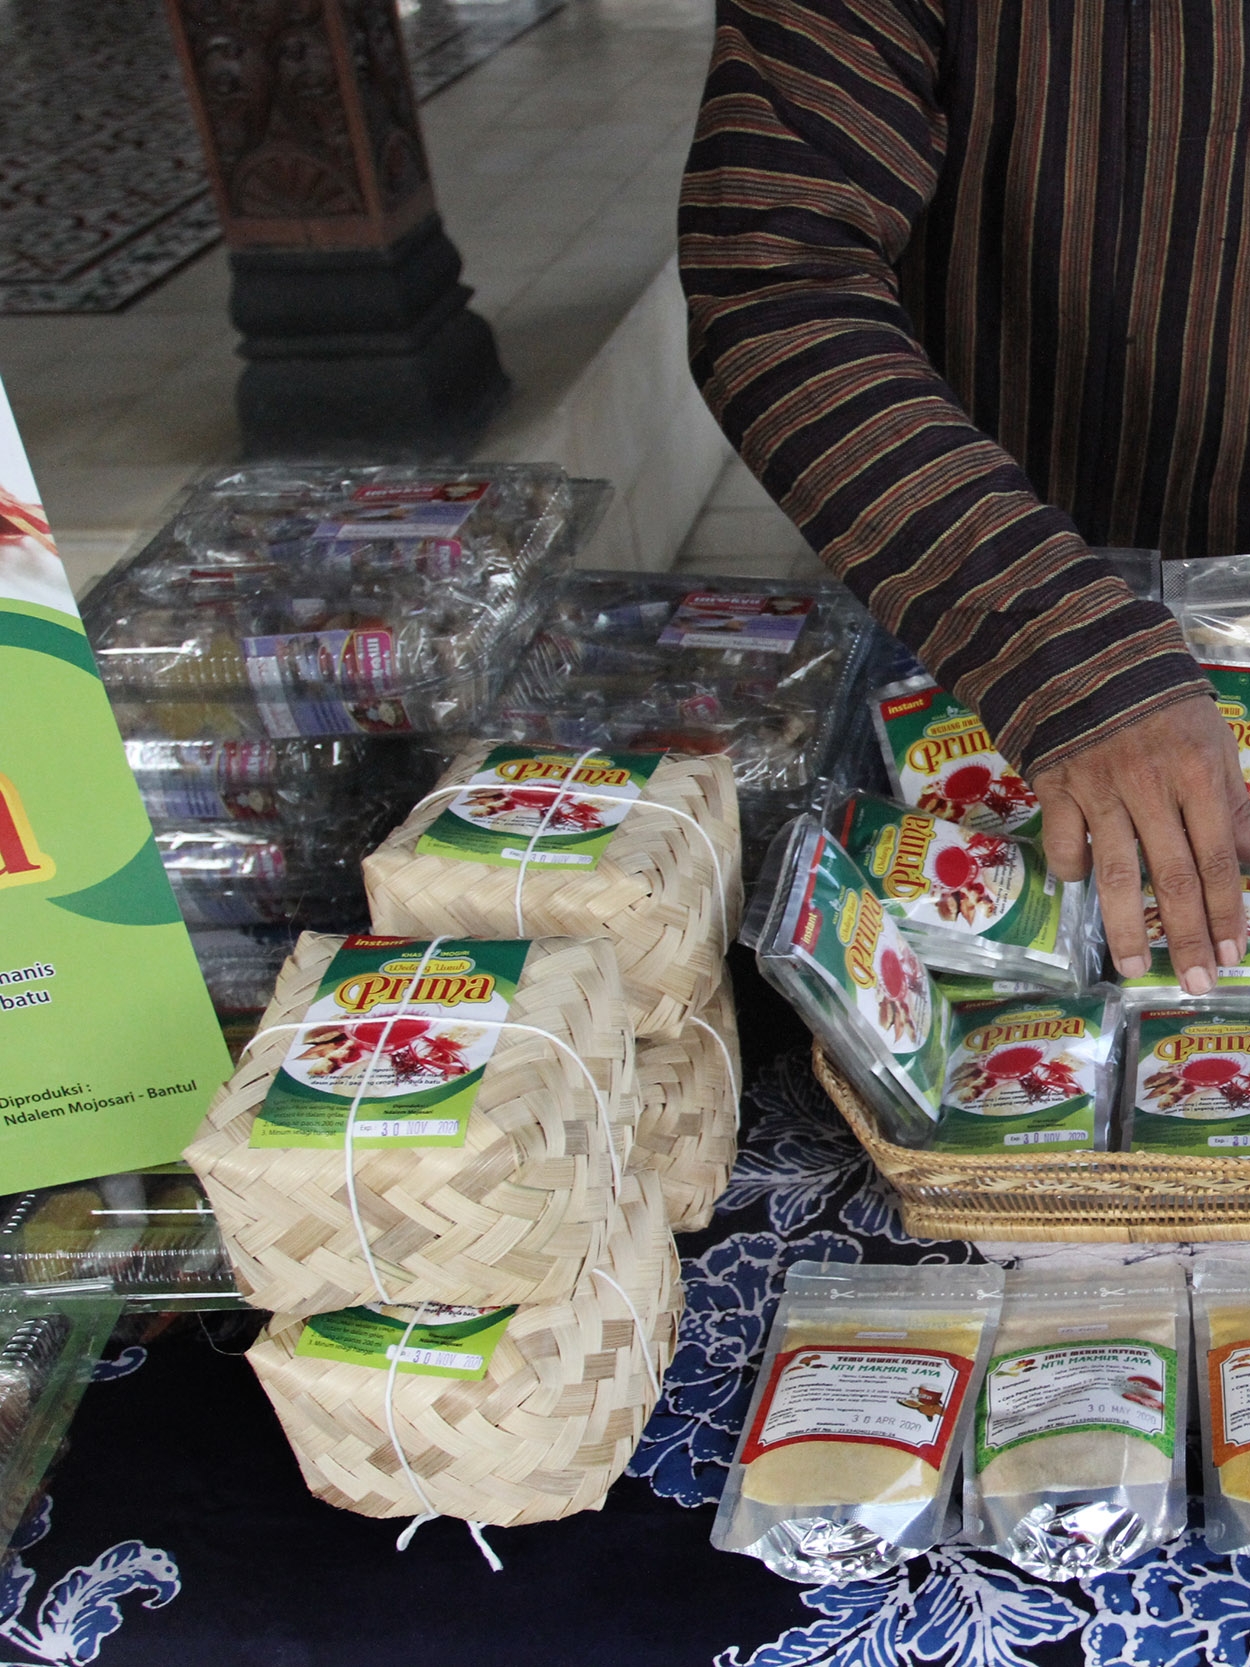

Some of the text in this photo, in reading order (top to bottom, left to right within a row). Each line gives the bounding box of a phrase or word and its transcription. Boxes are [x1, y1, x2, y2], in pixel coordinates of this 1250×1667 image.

[888, 699, 924, 715] instant
[962, 715, 982, 729] UWU
[909, 730, 996, 773] Prim
[500, 761, 629, 785] Prima
[887, 816, 931, 898] Prima
[801, 912, 818, 944] instant
[354, 938, 405, 947] instant
[849, 891, 882, 985] Prima
[388, 963, 431, 973] Wedag
[0, 990, 50, 1010] batu
[338, 976, 494, 1011] Prima
[965, 1018, 1081, 1051] Prima
[0, 1083, 84, 1109] Diproduksi
[3, 1079, 197, 1126] Ndalem Mojosari Bantul
[381, 1122, 400, 1136] 30
[406, 1122, 428, 1135] NOV
[1023, 1132, 1086, 1144] 30 NOV 2020
[412, 1350, 430, 1365] 30
[436, 1352, 457, 1366] NOV
[901, 1358, 943, 1368] INSTANT
[1069, 1355, 1119, 1364] MAKMUR
[1124, 1357, 1151, 1365] JAYA
[858, 1364, 908, 1373] MAKMUR
[912, 1369, 941, 1378] JAYA
[1088, 1404, 1105, 1413] 30
[1112, 1405, 1131, 1414] MAY
[875, 1416, 895, 1424] APR
[900, 1420, 921, 1431] 2020
